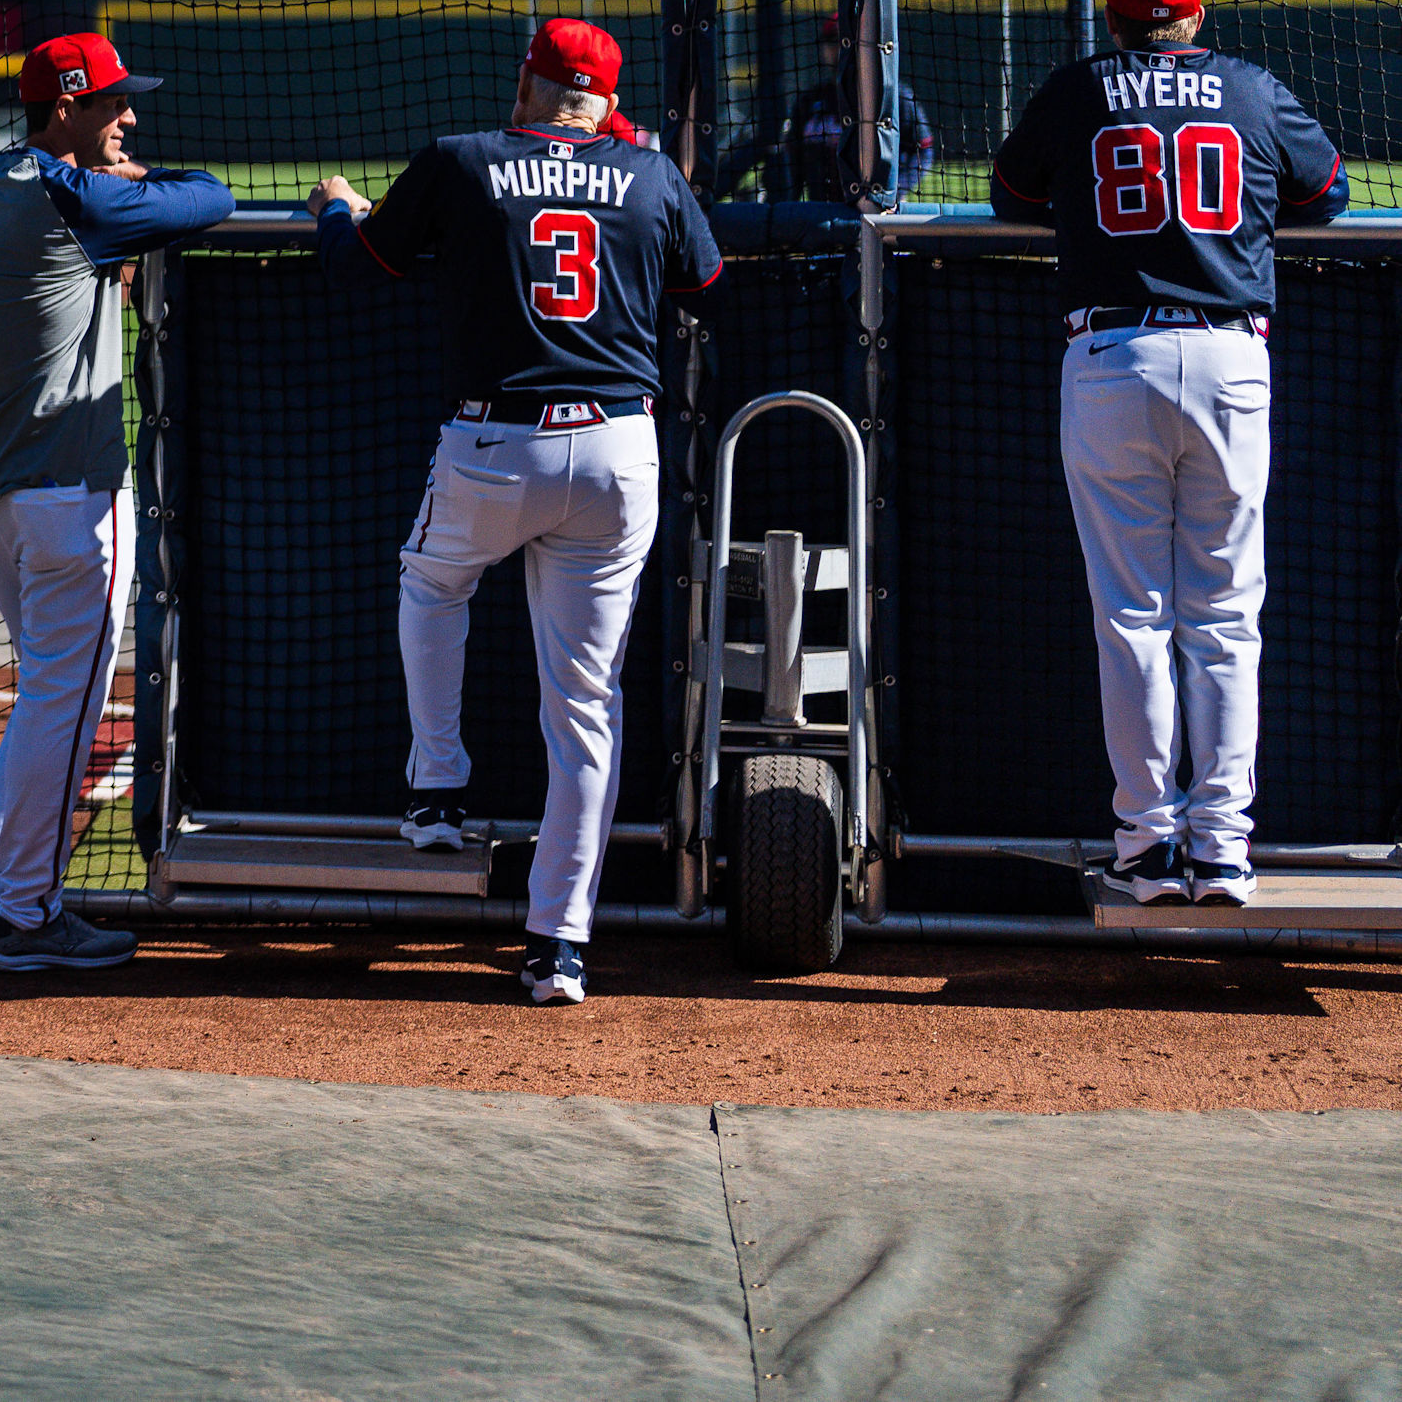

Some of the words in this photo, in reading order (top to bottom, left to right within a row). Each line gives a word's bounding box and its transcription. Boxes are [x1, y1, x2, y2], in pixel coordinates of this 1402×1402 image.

[1103, 71, 1223, 112] HYERS
[489, 159, 635, 207] MURPHY
[1091, 122, 1243, 237] 80
[530, 208, 600, 322] 3
